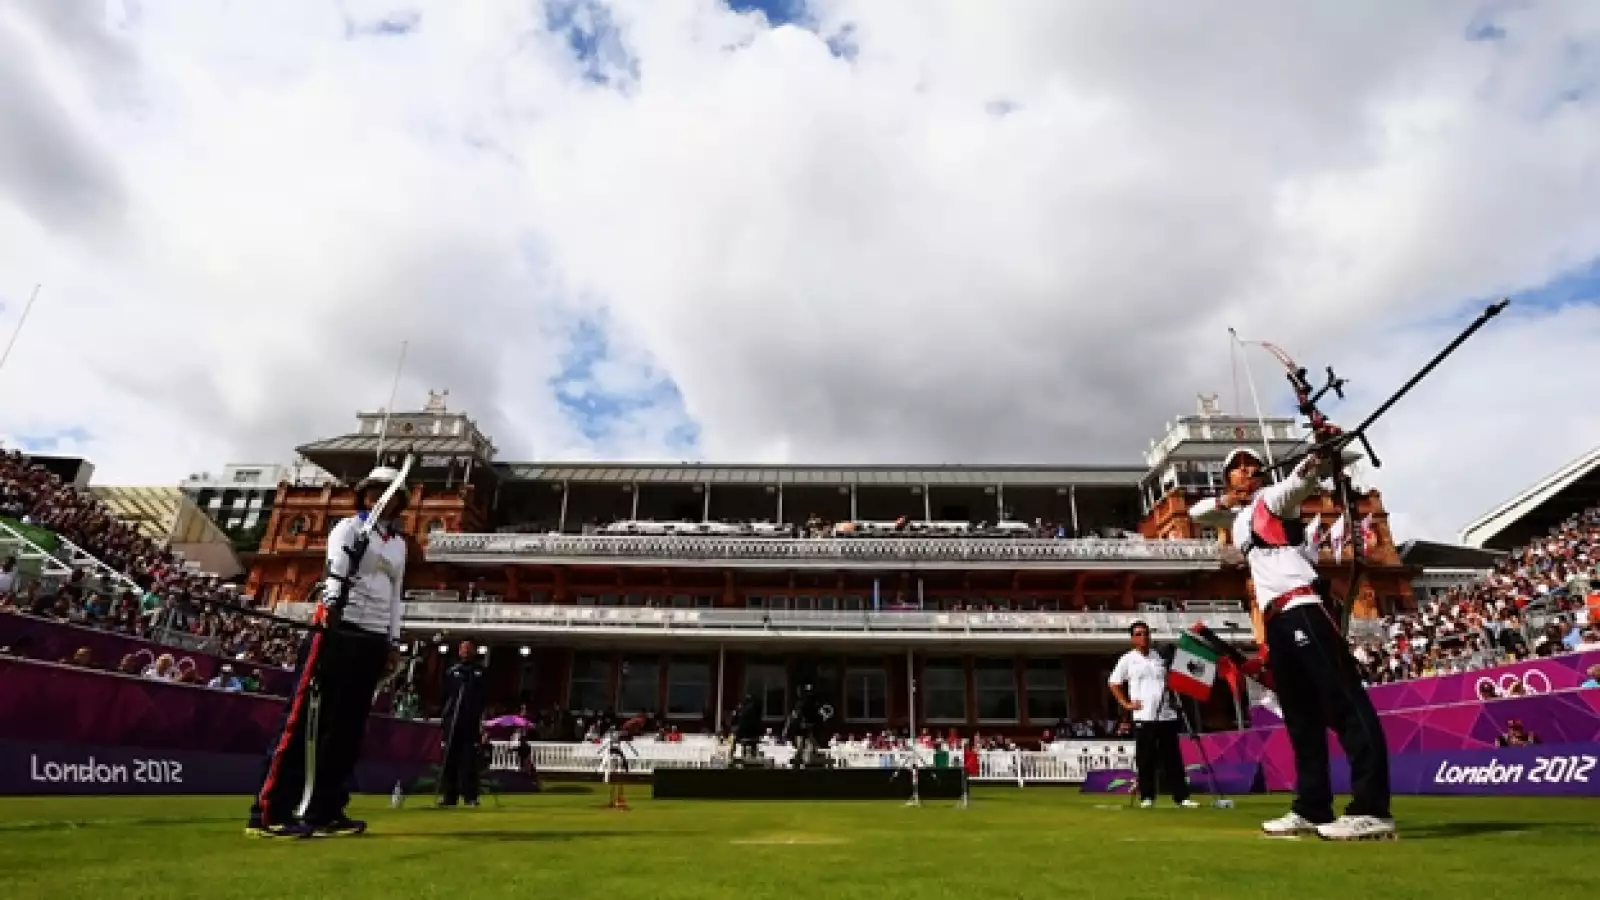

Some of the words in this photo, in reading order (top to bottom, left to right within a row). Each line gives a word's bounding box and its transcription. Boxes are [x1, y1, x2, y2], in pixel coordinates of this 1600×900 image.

[31, 754, 127, 782] London
[133, 759, 182, 782] 2012
[1435, 758, 1523, 783] London
[1528, 754, 1597, 783] 2012
